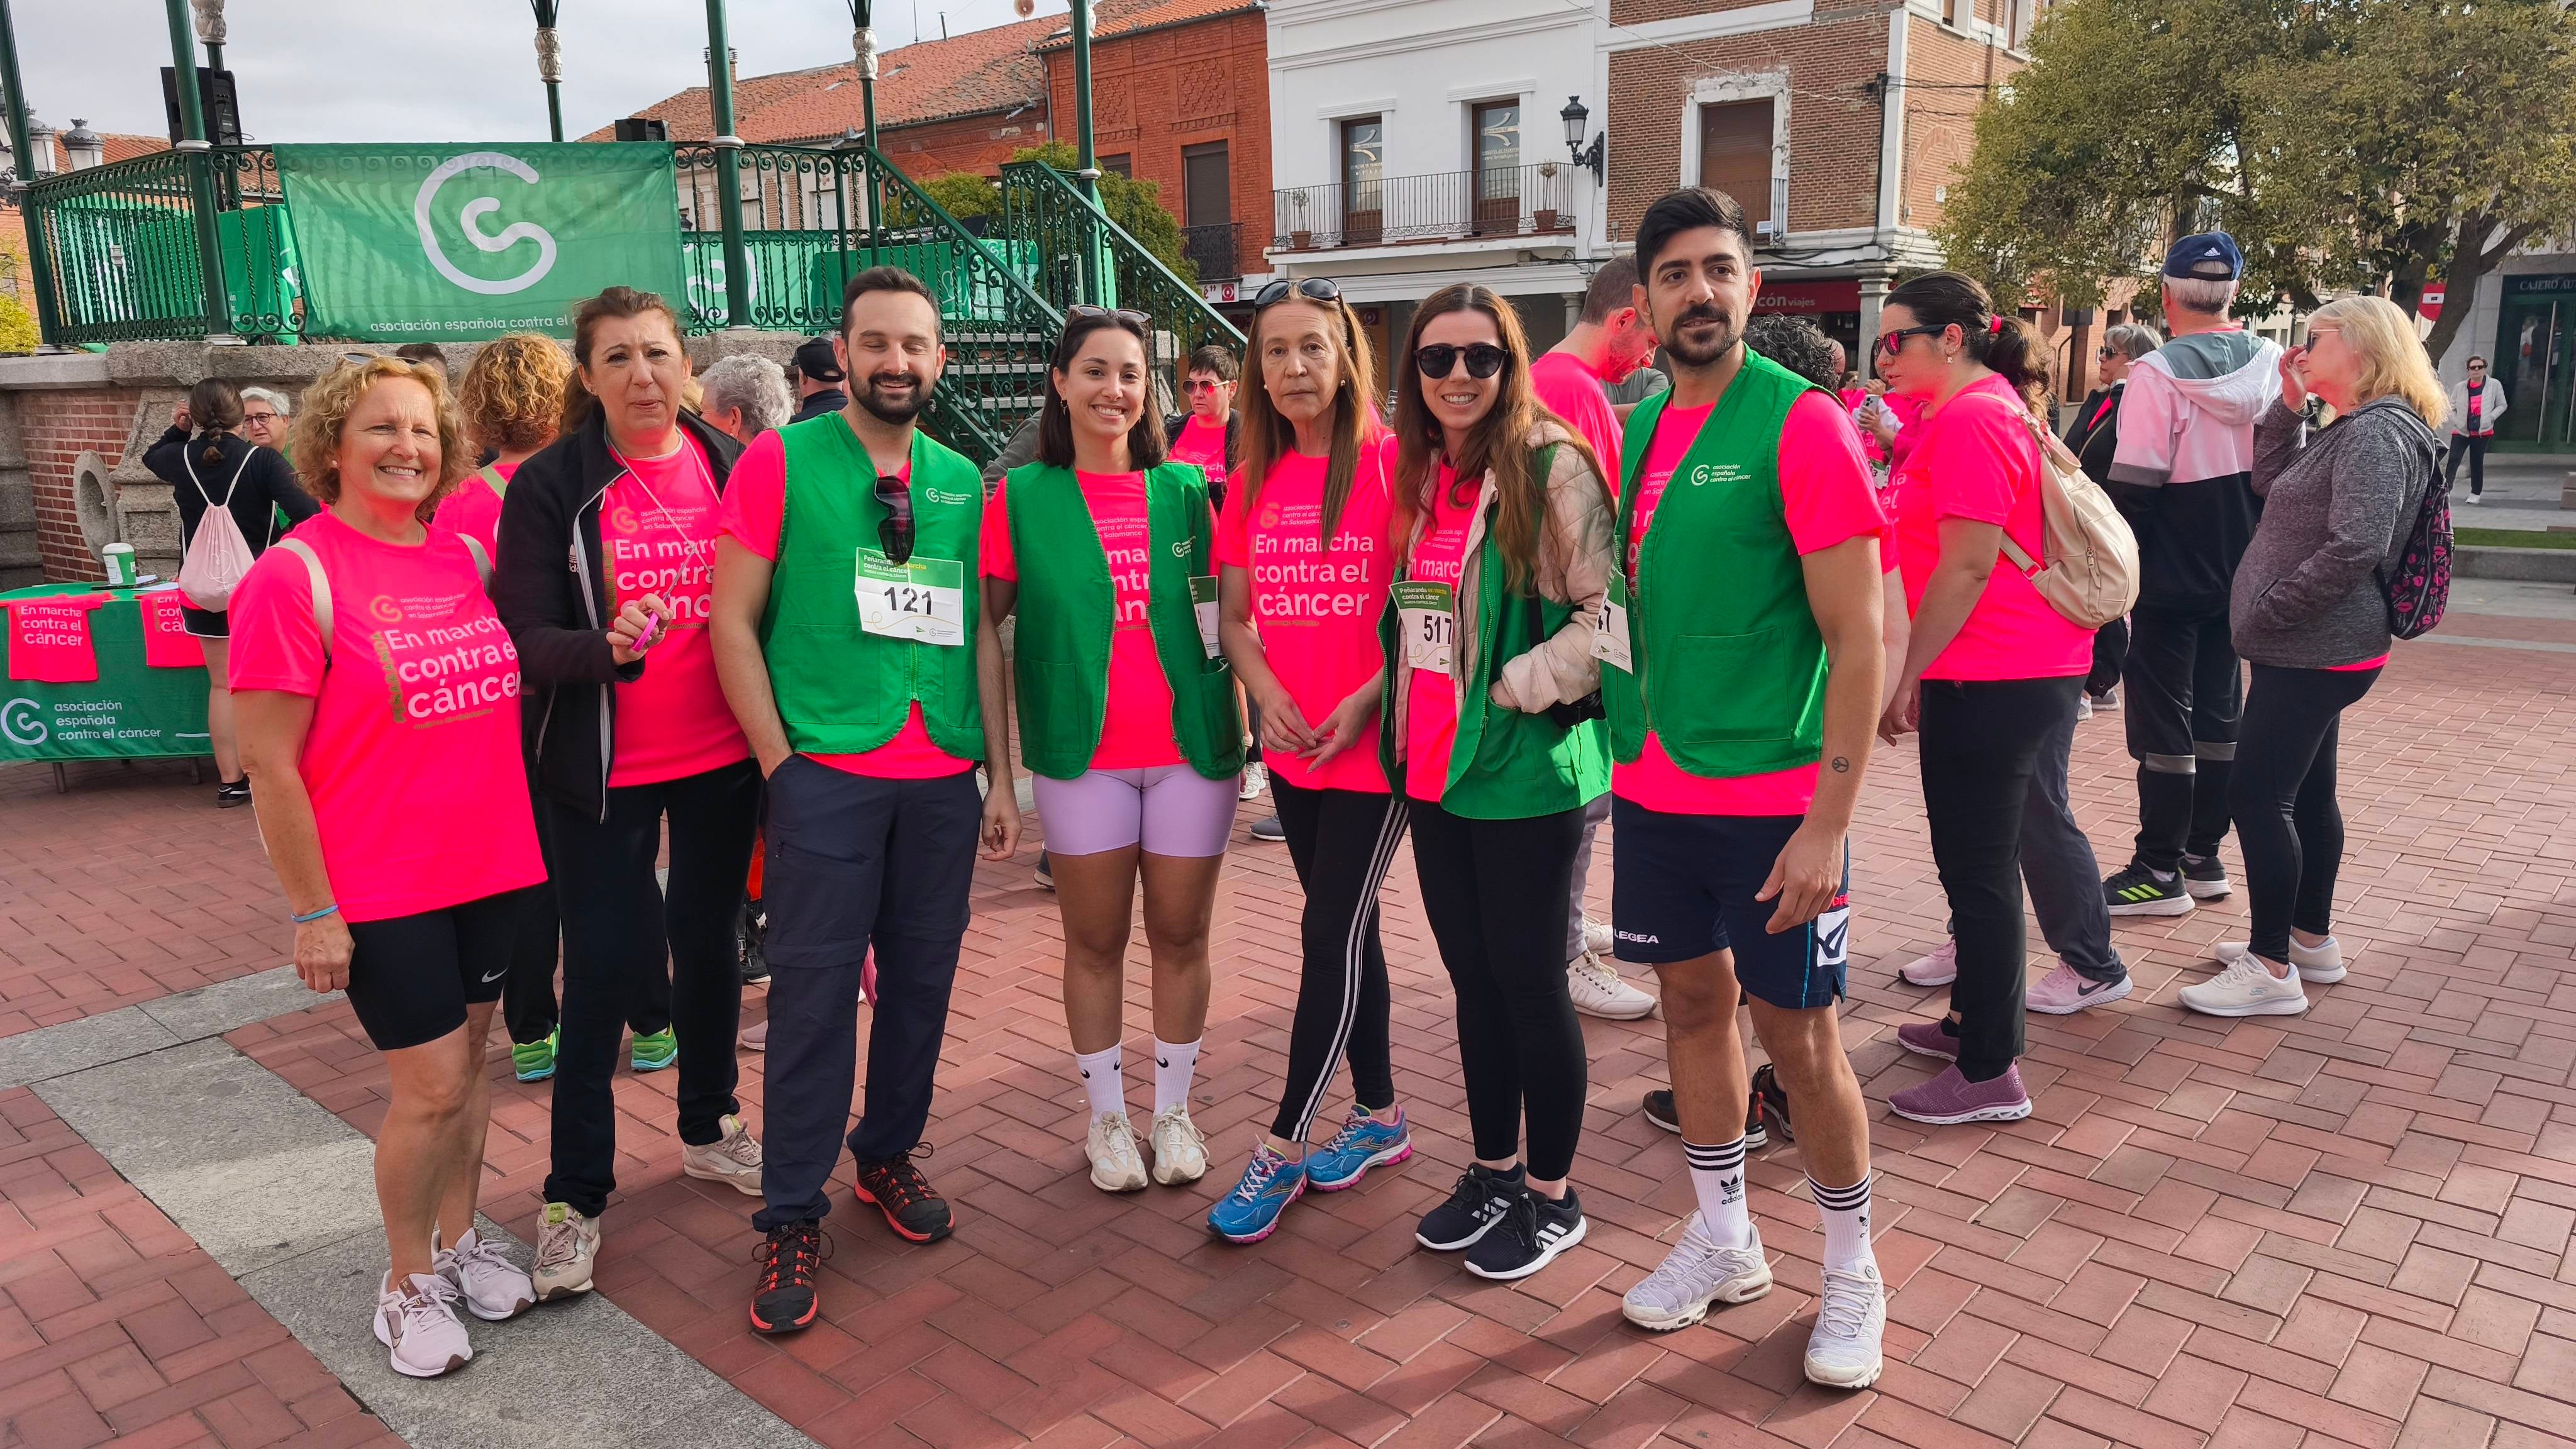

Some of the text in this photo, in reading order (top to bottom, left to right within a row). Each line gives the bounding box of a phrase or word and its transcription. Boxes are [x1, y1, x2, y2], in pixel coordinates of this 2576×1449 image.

[1757, 292, 1816, 308] cón viajes
[370, 319, 440, 332] asociación
[444, 317, 506, 332] española
[510, 315, 553, 328] contra
[557, 313, 569, 326] el
[615, 538, 650, 559] En
[1255, 534, 1277, 553] En
[863, 562, 882, 571] contra
[1255, 558, 1369, 584] contra el
[884, 586, 932, 615] 121
[1259, 586, 1370, 616] cáncer
[21, 605, 82, 617] En marcha
[21, 618, 82, 631] contra el
[1424, 614, 1452, 645] 517
[24, 630, 84, 647] cáncer
[384, 629, 425, 650] En
[399, 644, 502, 683] contra
[54, 699, 123, 713] asociación
[56, 714, 116, 728] española
[57, 726, 162, 741] contra el cáncer
[1614, 928, 1660, 944] LEGEA
[1721, 1193, 1743, 1205] adidas
